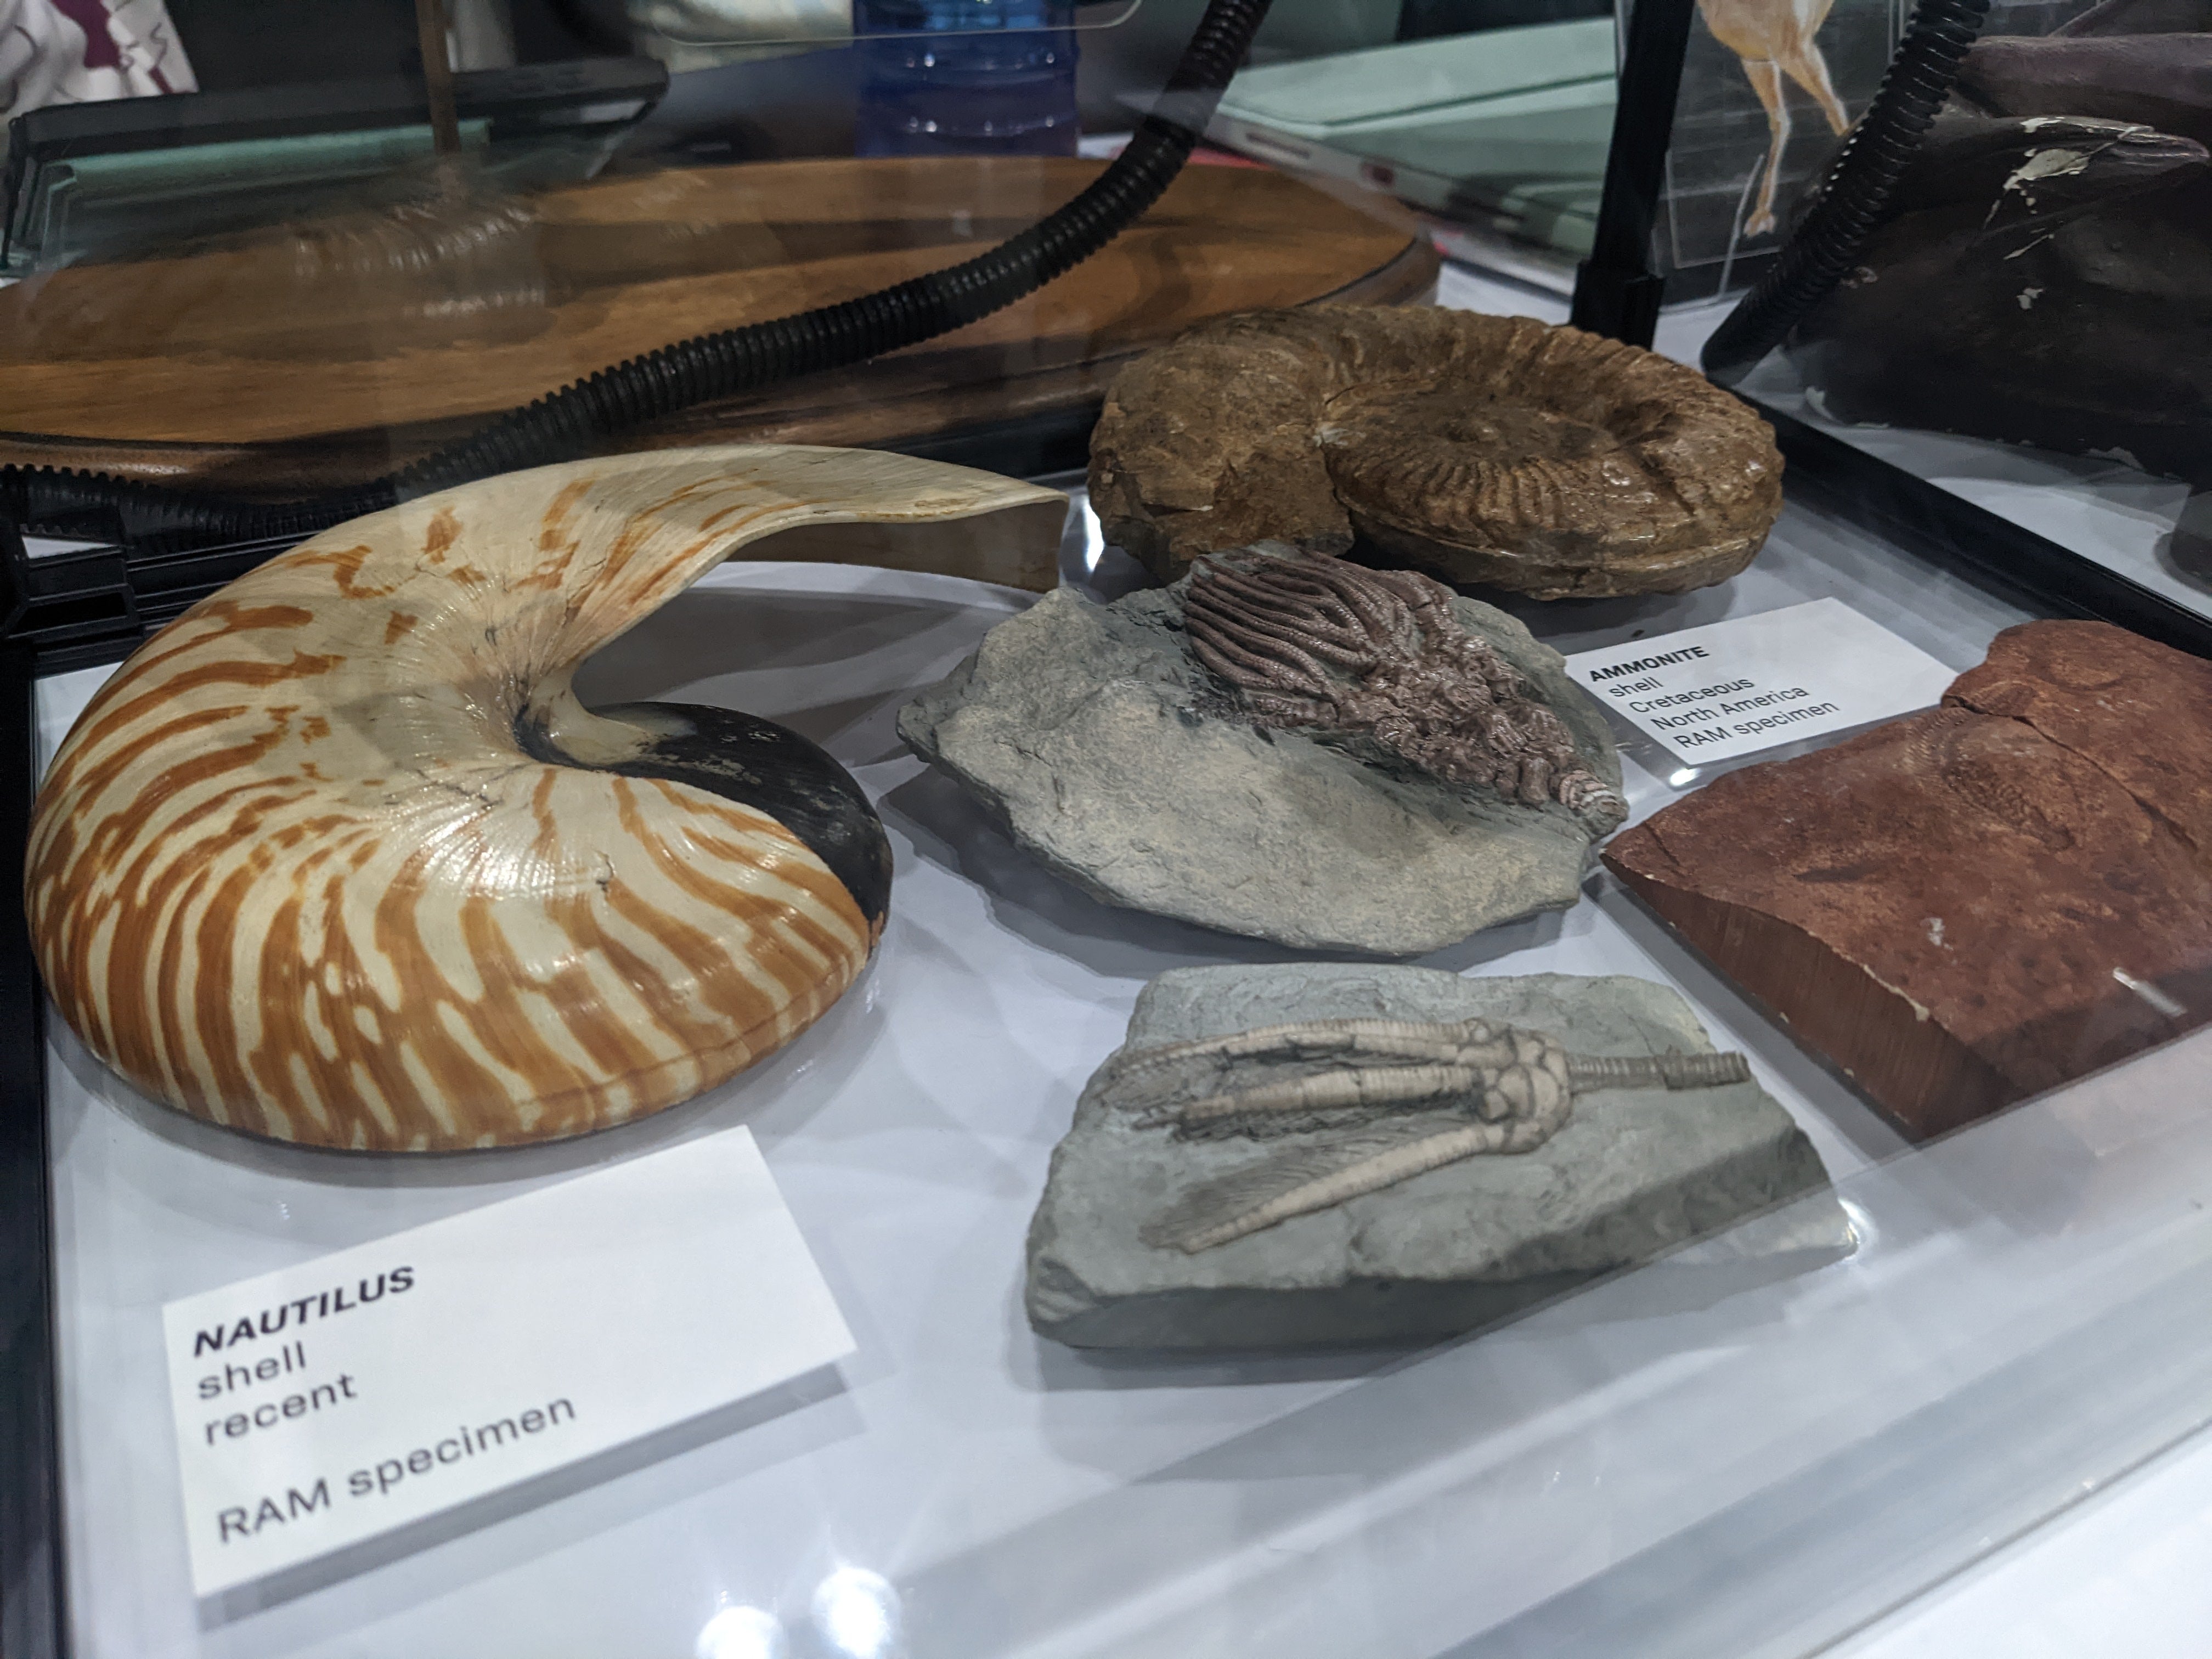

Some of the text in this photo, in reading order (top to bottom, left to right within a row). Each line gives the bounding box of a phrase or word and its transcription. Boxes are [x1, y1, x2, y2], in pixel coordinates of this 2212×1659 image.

[1589, 646, 1710, 682] AMMONITE
[1609, 676, 1663, 698] shell
[1629, 678, 1755, 713] Cretaceous
[1650, 687, 1810, 730] North America
[1673, 702, 1840, 748] RAM specimen
[192, 1265, 416, 1359] NAUTILUS
[198, 1340, 307, 1401] shell
[205, 1374, 358, 1446] recent
[217, 1398, 577, 1544] RAM specimen
